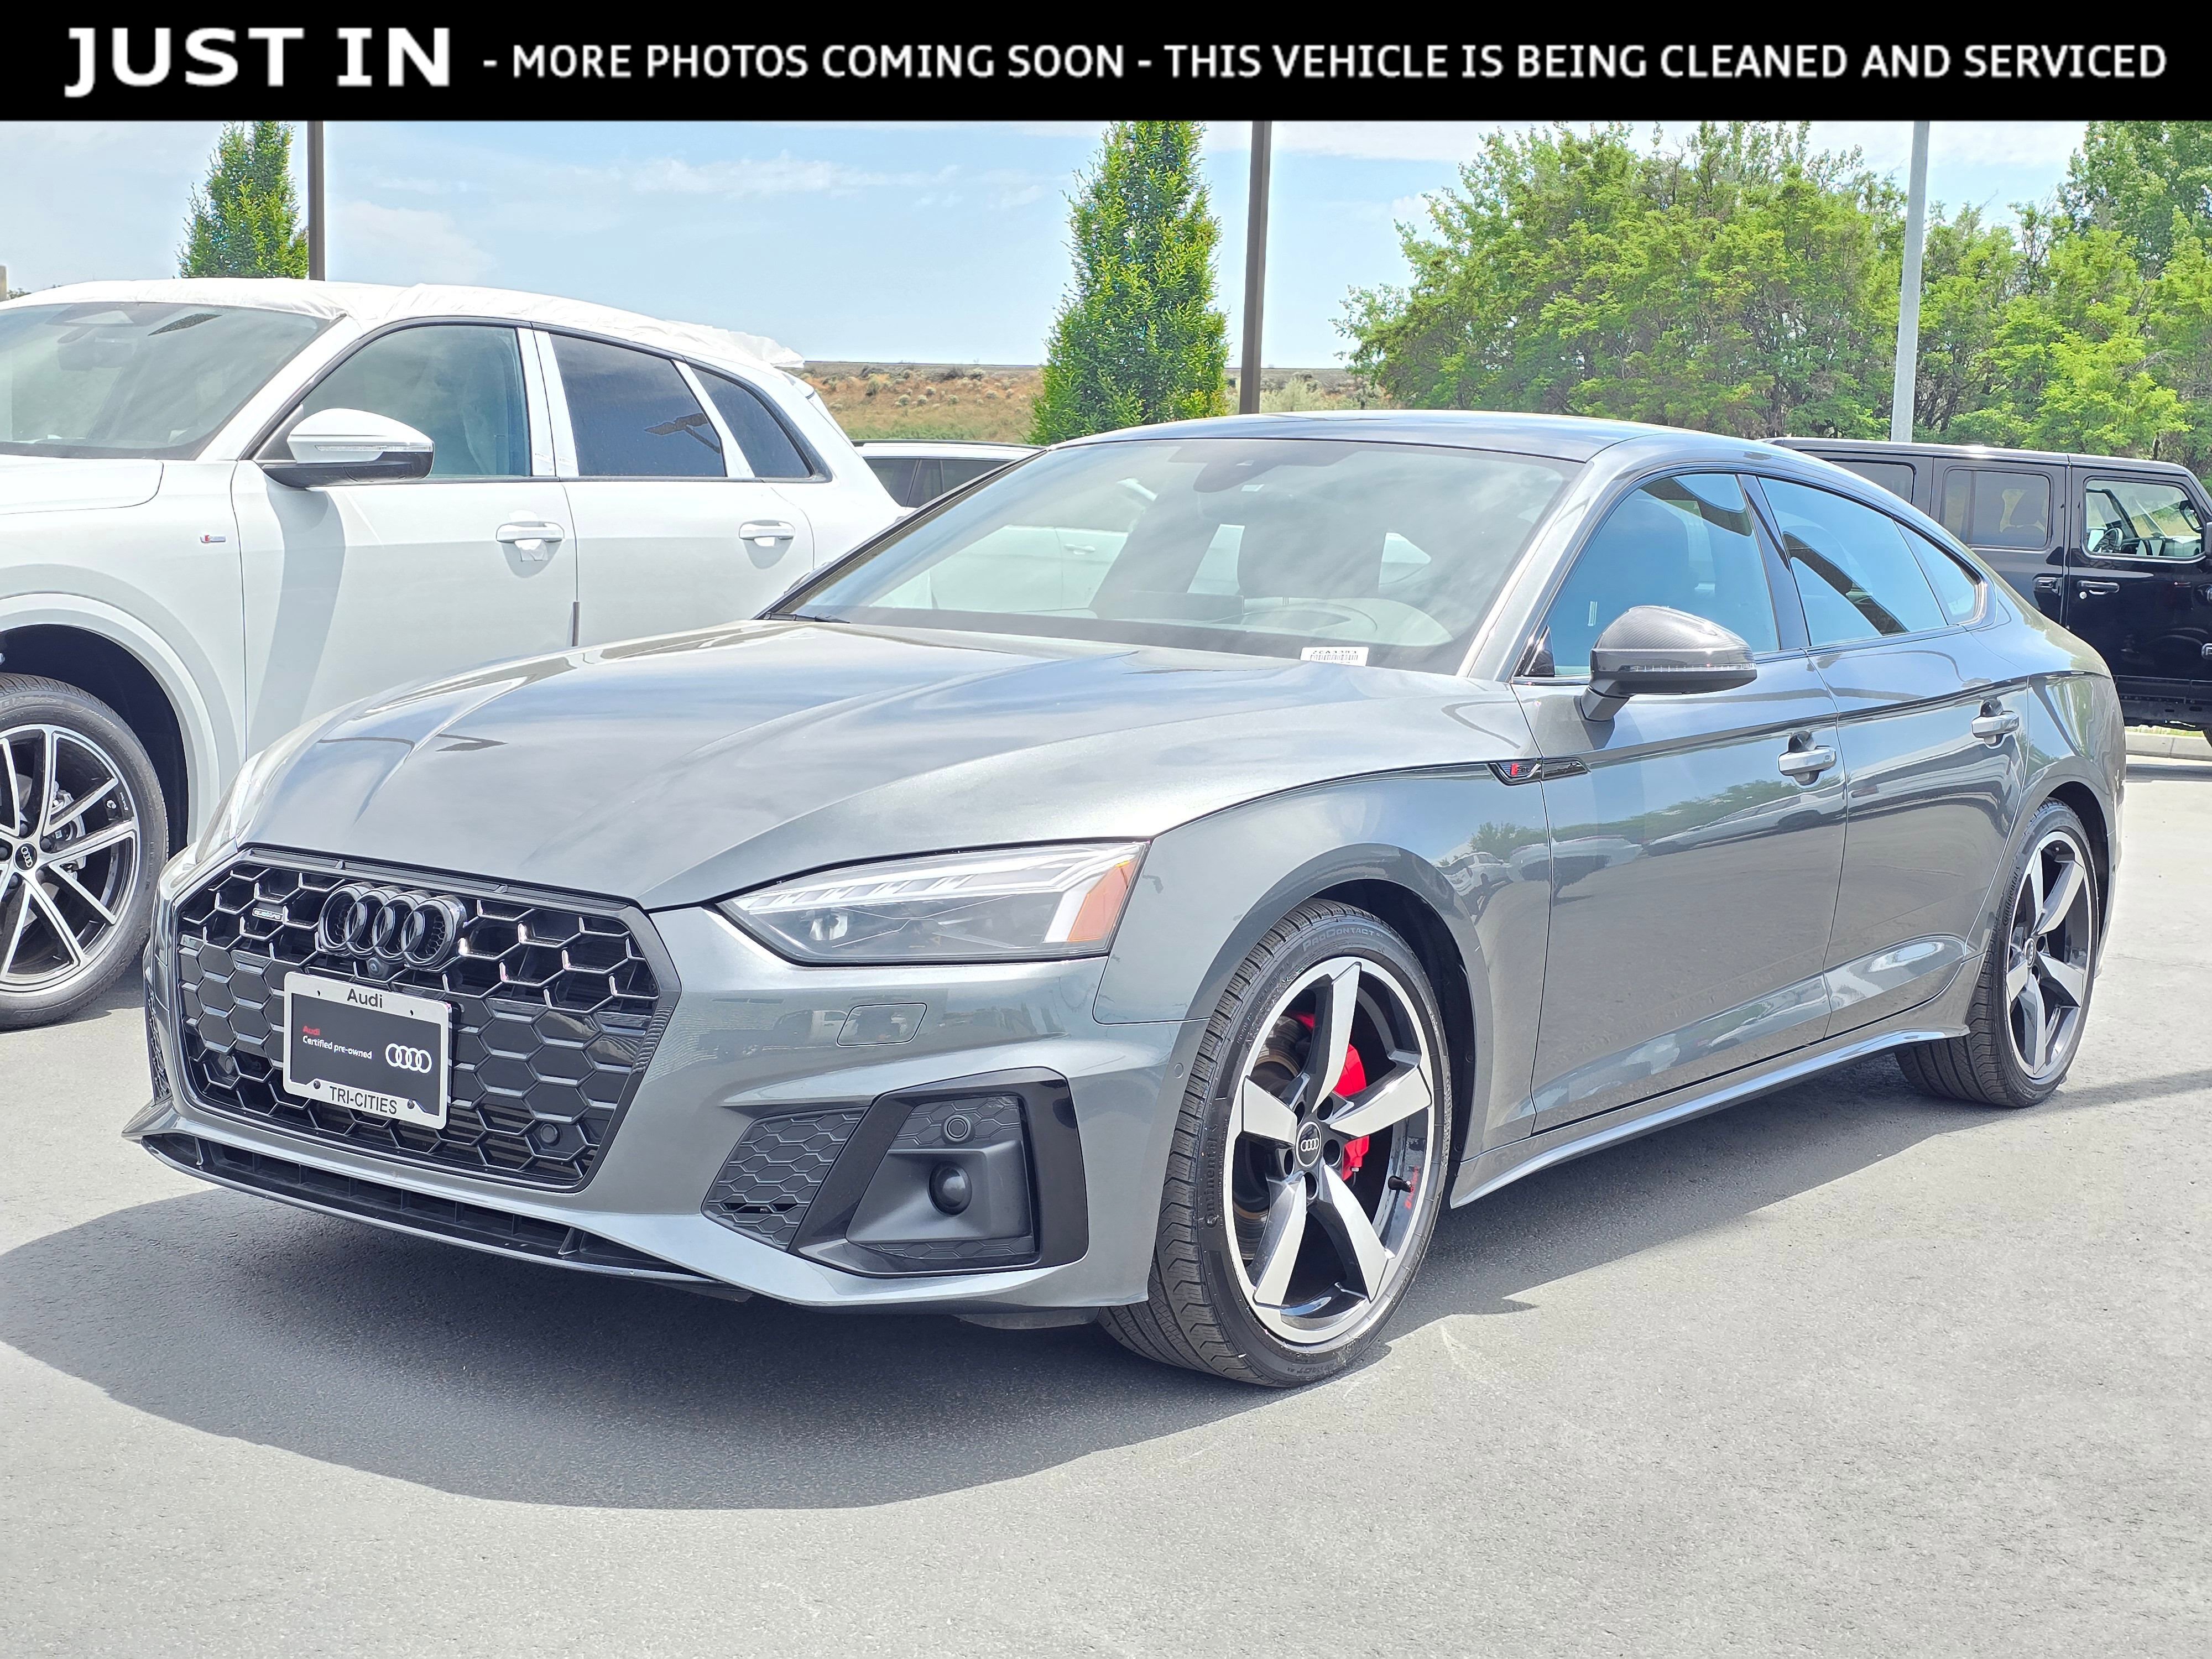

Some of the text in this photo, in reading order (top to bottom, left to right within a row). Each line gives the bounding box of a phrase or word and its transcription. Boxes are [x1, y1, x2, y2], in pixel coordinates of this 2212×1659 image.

[347, 988, 383, 1009] Audi
[302, 1026, 320, 1036] Audi
[302, 1035, 372, 1060] Certified pre-owned
[329, 1086, 398, 1115] TRI-CITIES
